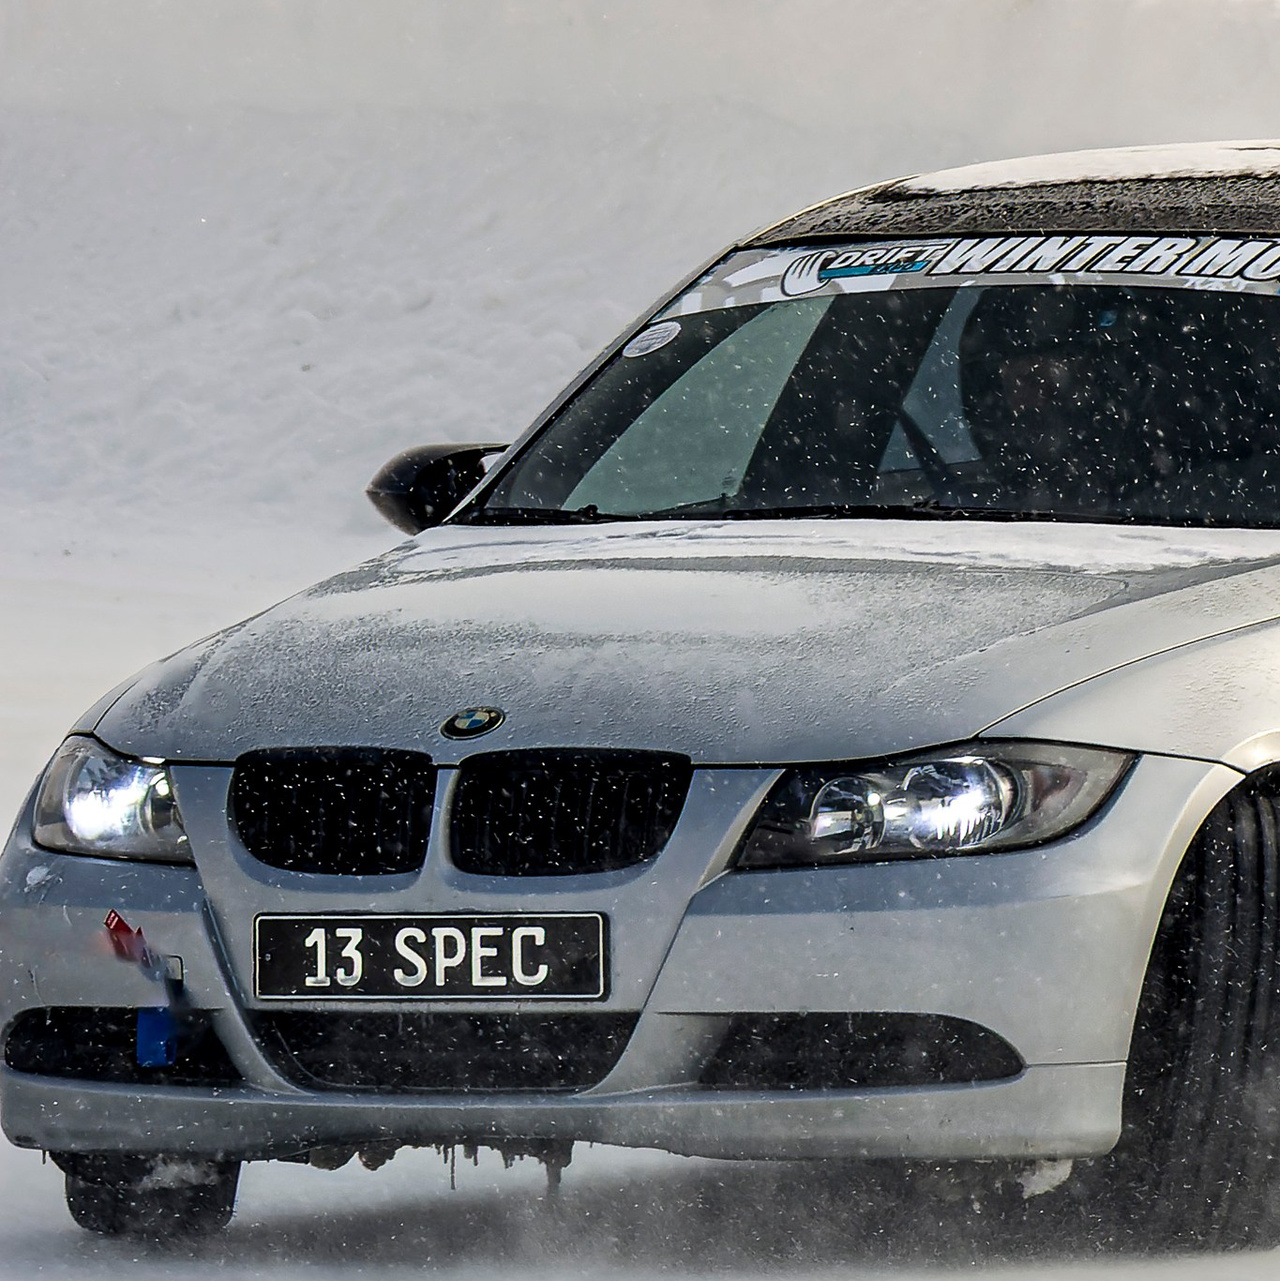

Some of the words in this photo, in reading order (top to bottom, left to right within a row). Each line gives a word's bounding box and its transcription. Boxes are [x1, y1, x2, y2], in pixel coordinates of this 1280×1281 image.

[825, 244, 949, 270] DRIFT
[926, 235, 1199, 275] WINTER
[303, 927, 362, 987] 13
[394, 926, 549, 986] SPEC
